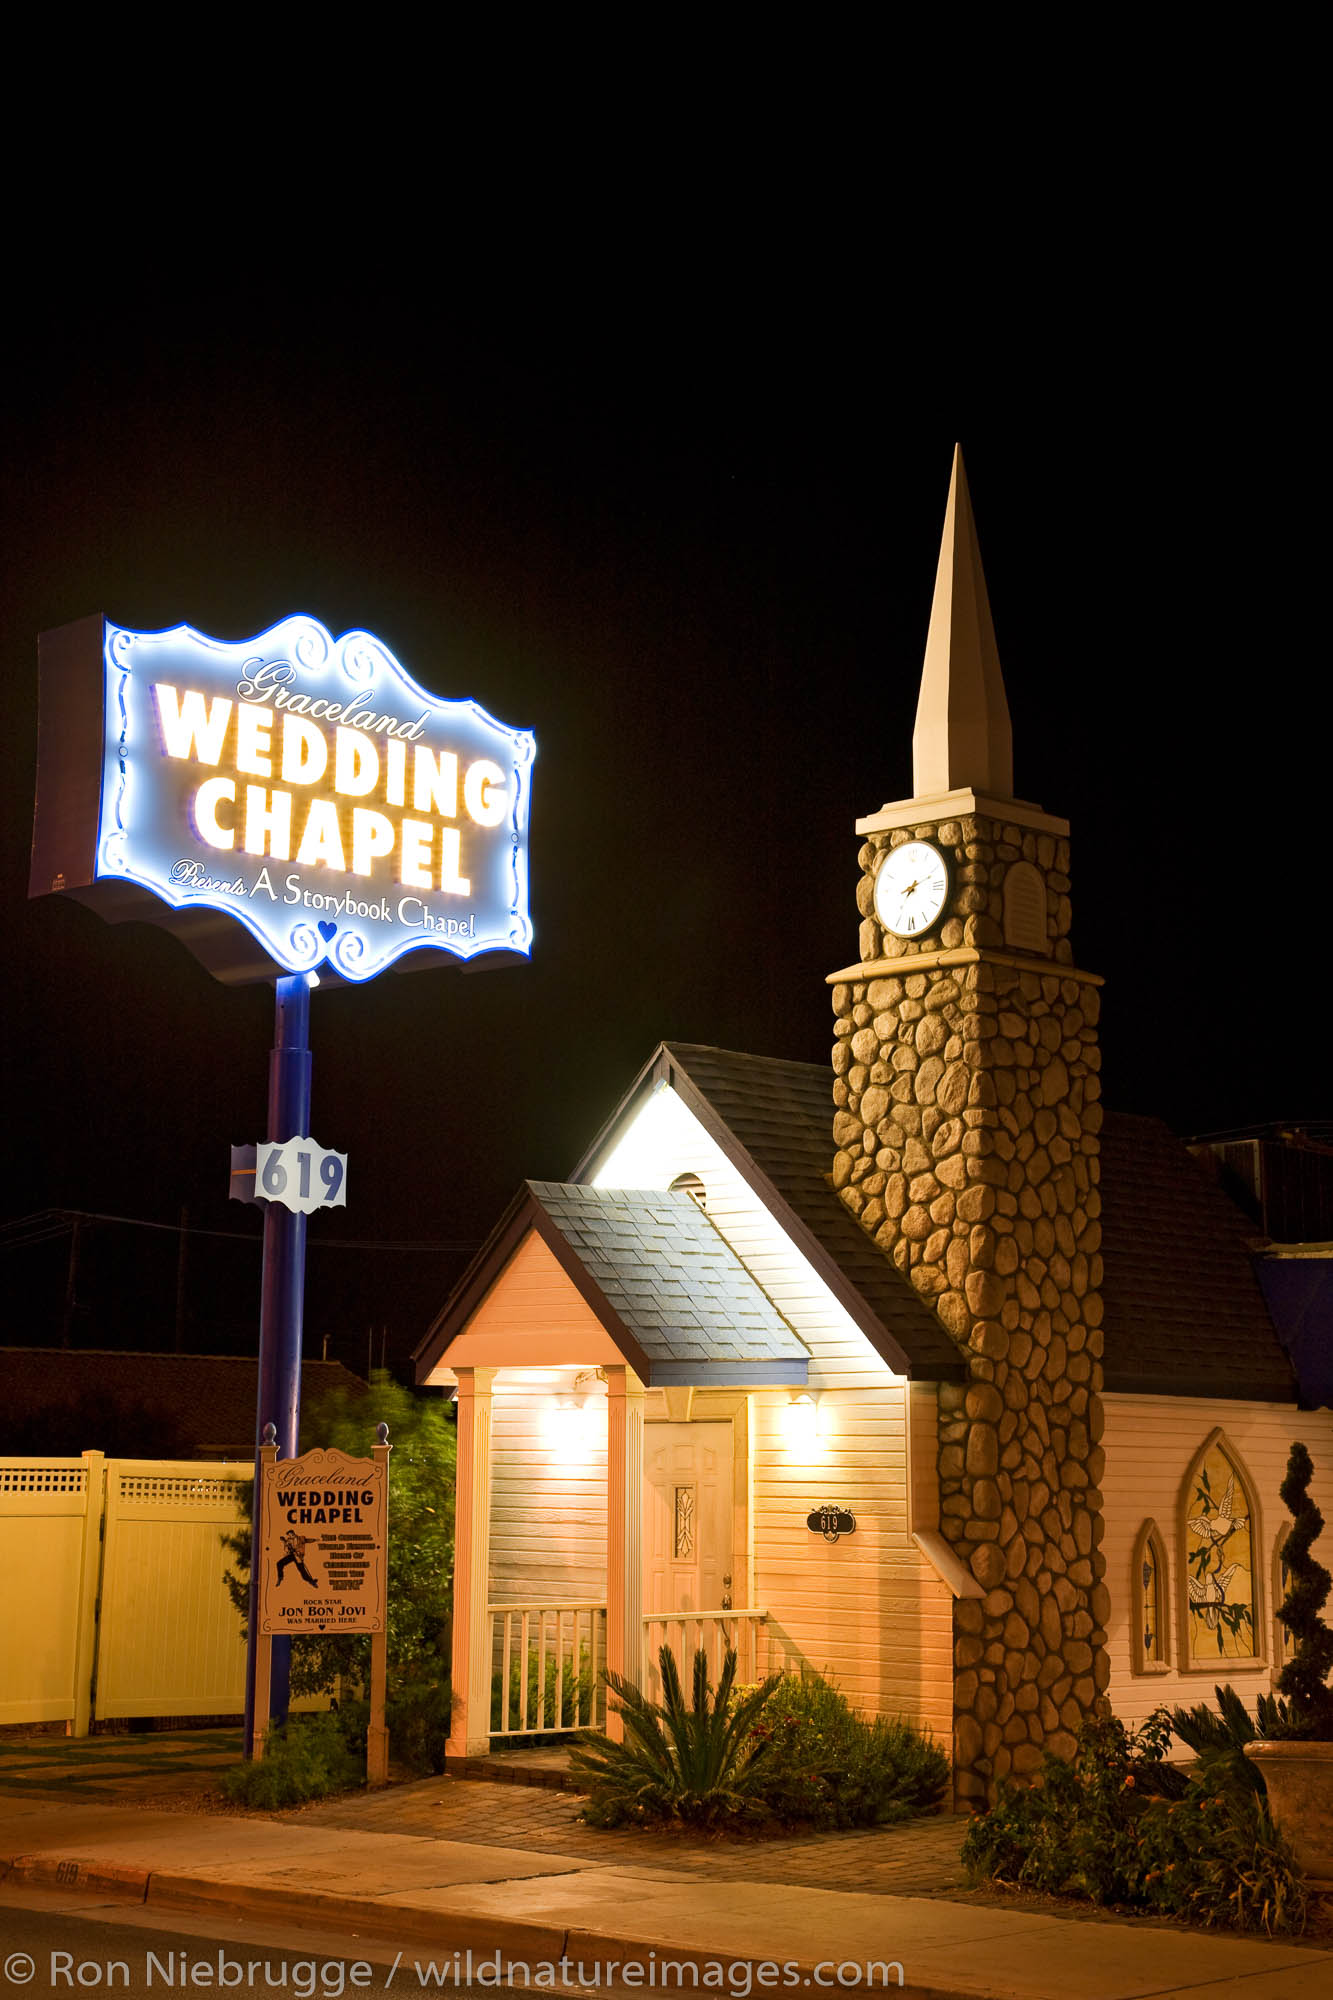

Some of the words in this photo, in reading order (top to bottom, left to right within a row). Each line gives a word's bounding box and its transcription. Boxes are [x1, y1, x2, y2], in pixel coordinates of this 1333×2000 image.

[236, 657, 431, 741] Graceland
[152, 683, 508, 827] WEDDING
[193, 777, 471, 896] CHAPEL
[170, 858, 248, 896] Presents
[249, 867, 278, 901] A
[283, 874, 393, 923] Storybook
[397, 897, 475, 938] Chapel
[262, 1149, 343, 1201] 619
[275, 1464, 375, 1488] Graceland
[277, 1490, 374, 1507] WEDDING
[286, 1508, 363, 1524] CHAPEL
[820, 1515, 838, 1530] 619
[278, 1606, 303, 1617] JON
[308, 1606, 334, 1616] BON
[338, 1605, 366, 1616] JOVI
